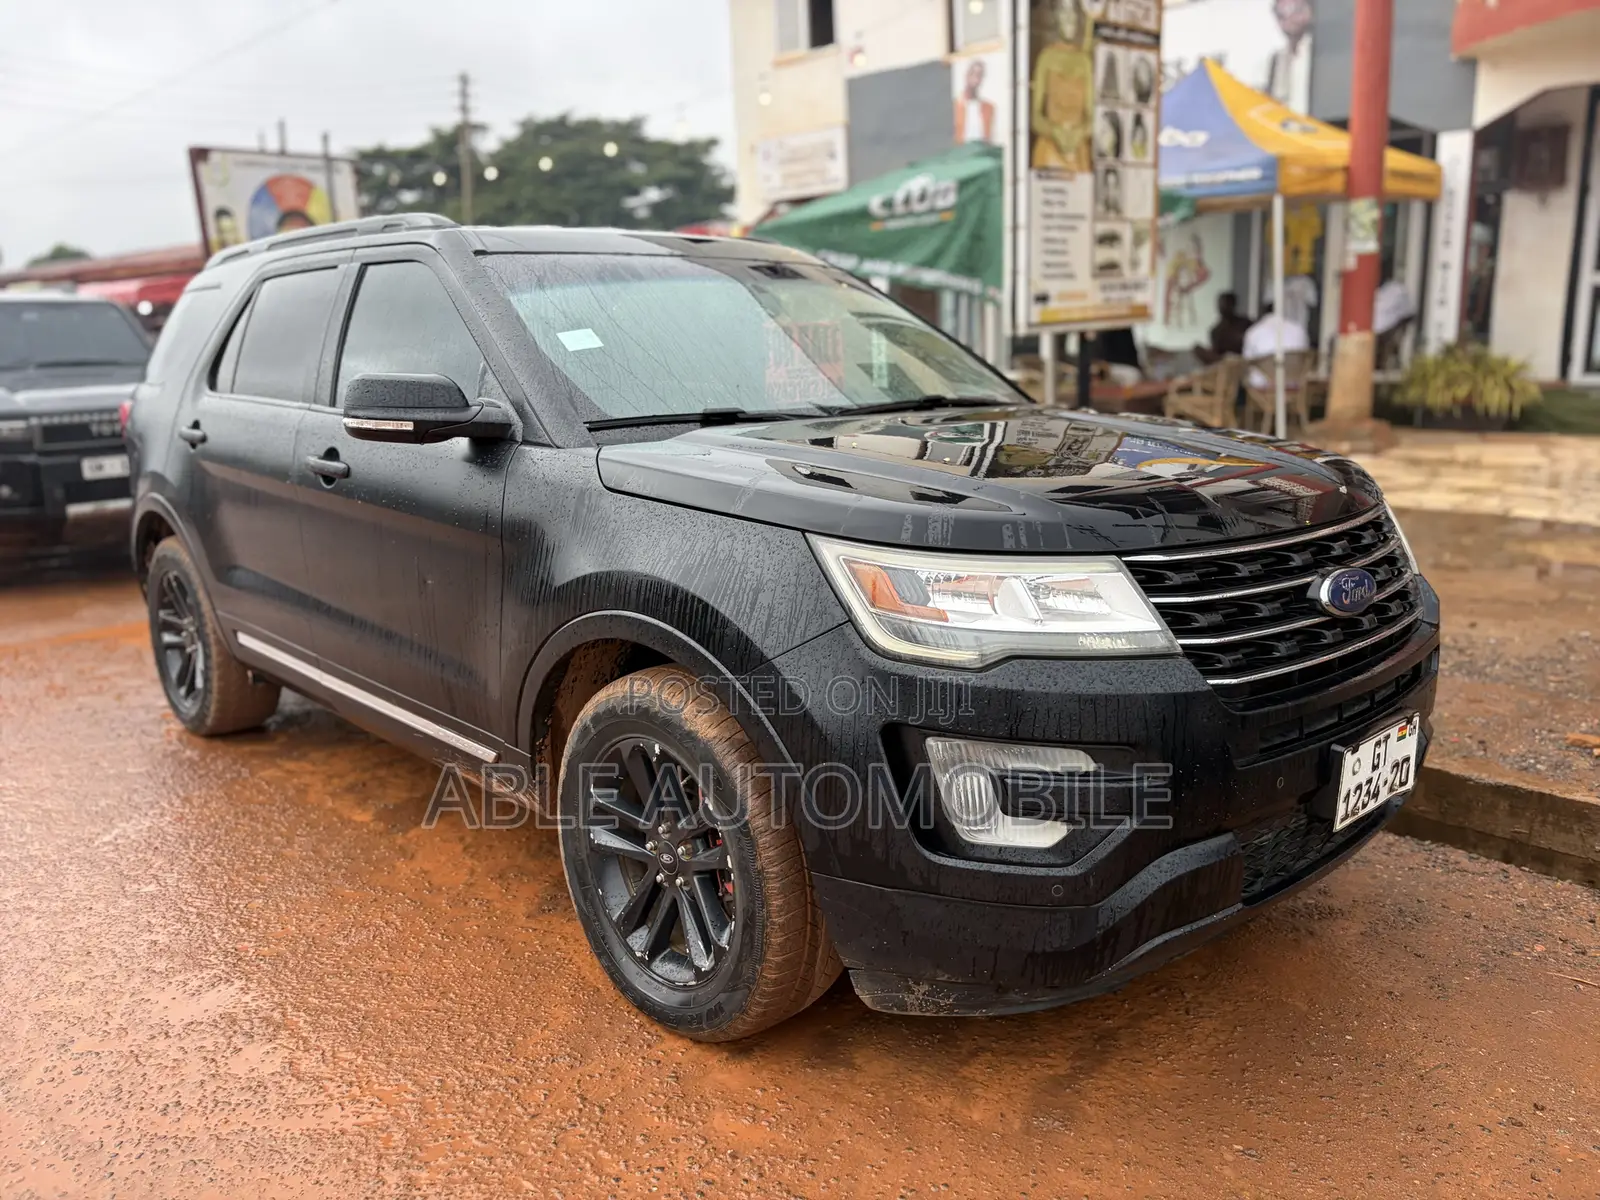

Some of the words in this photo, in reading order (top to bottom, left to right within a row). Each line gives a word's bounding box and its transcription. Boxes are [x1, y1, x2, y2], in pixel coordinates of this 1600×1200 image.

[1339, 574, 1372, 605] Ford
[1371, 733, 1391, 772] GT
[1340, 756, 1411, 823] 1234-20
